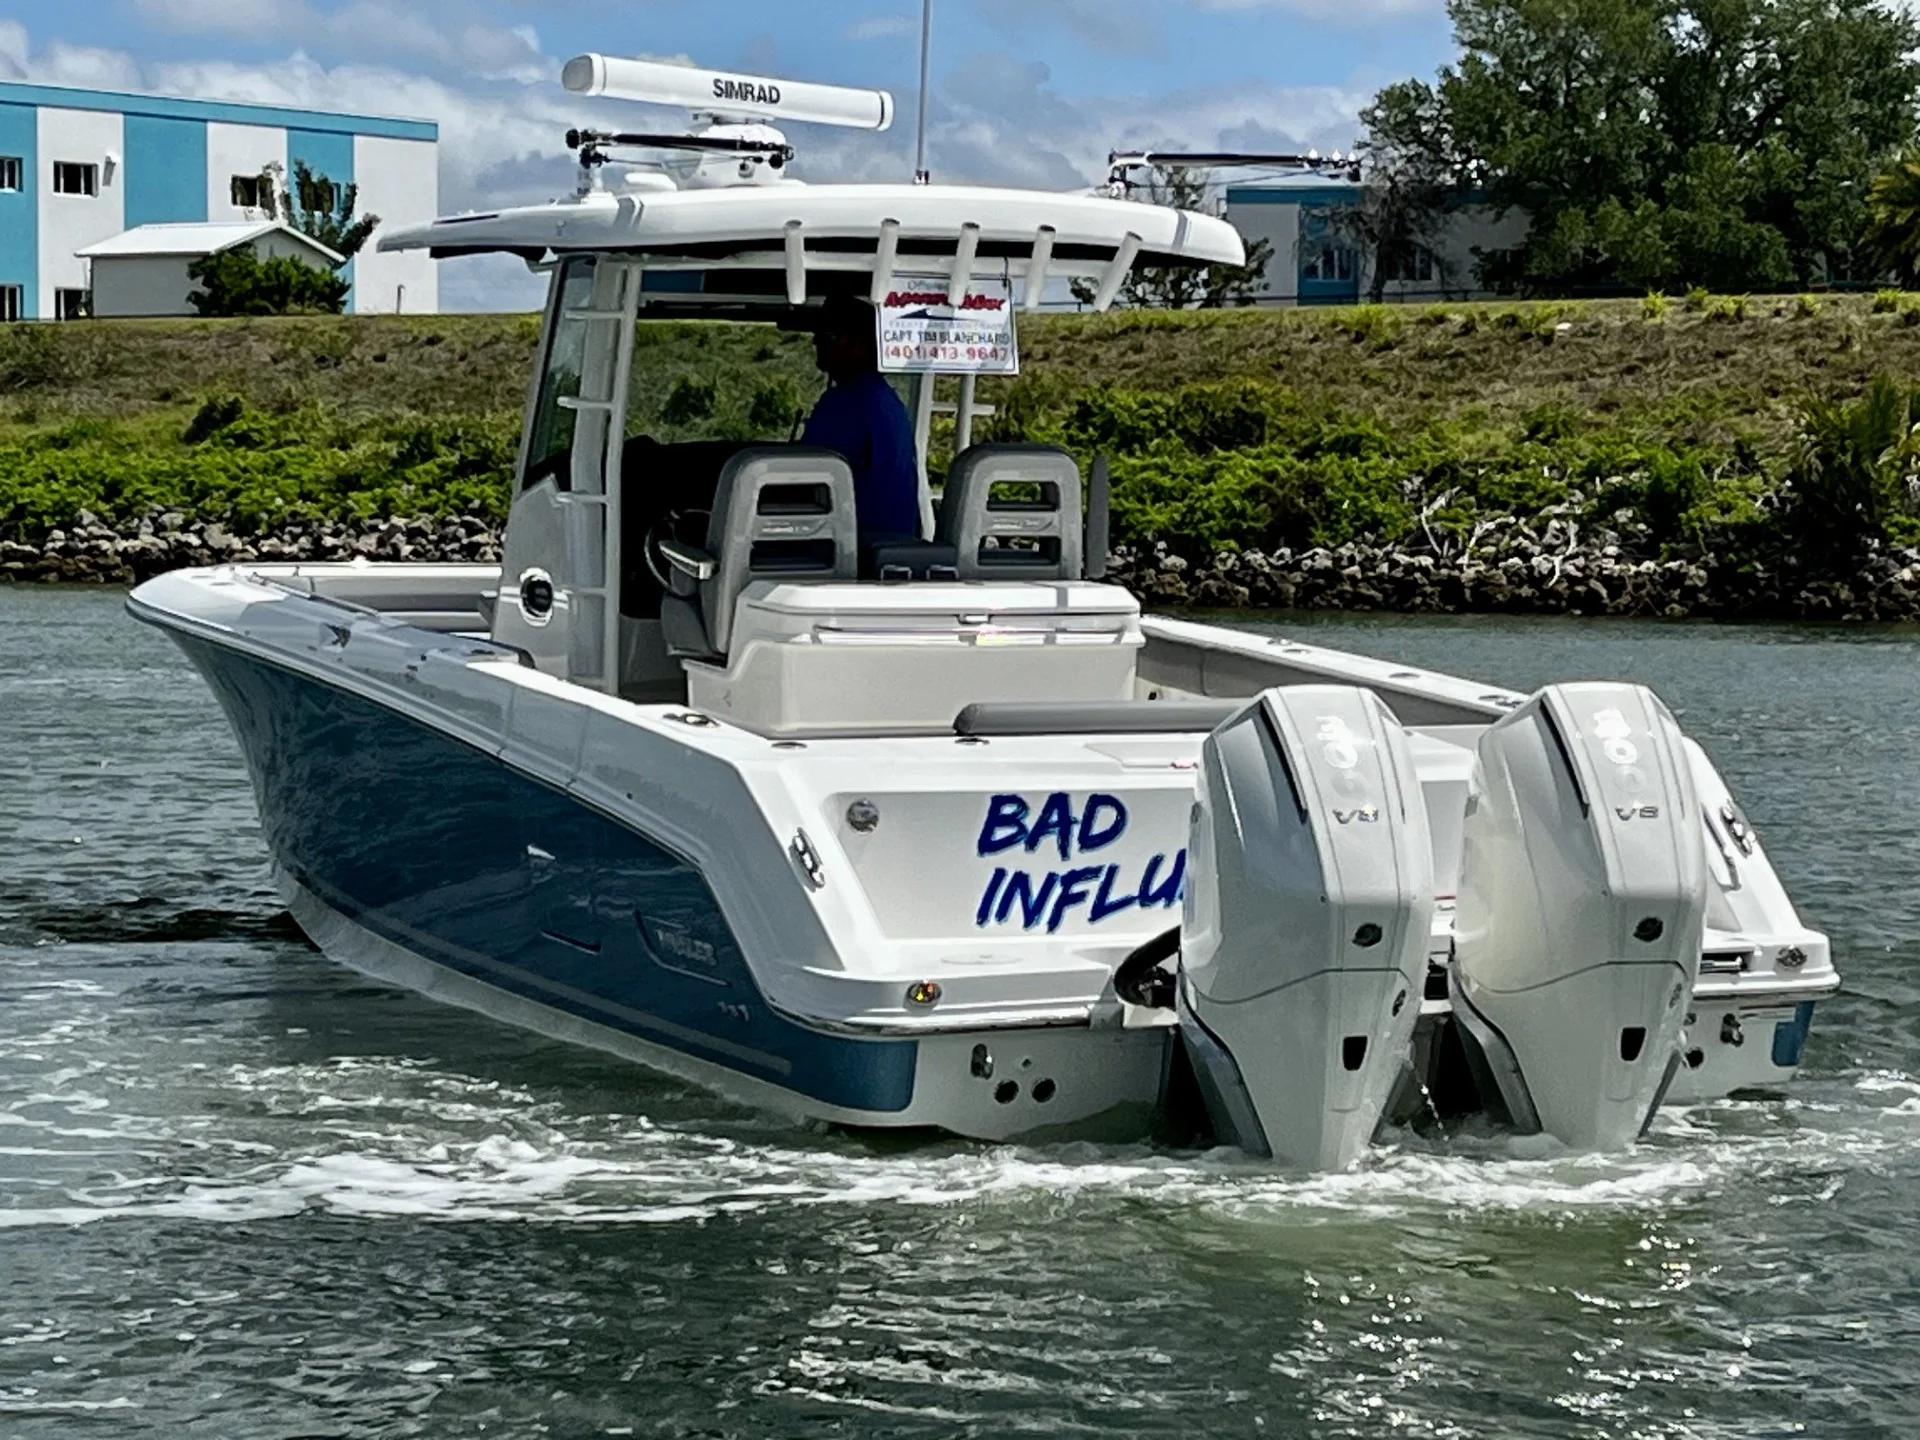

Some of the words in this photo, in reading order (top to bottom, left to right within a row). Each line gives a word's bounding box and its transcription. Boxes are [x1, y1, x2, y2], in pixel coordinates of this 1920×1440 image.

[713, 78, 780, 104] SIMRAD
[977, 791, 1128, 860] BAD
[1615, 805, 1659, 821] V8
[976, 848, 1187, 934] INFLU
